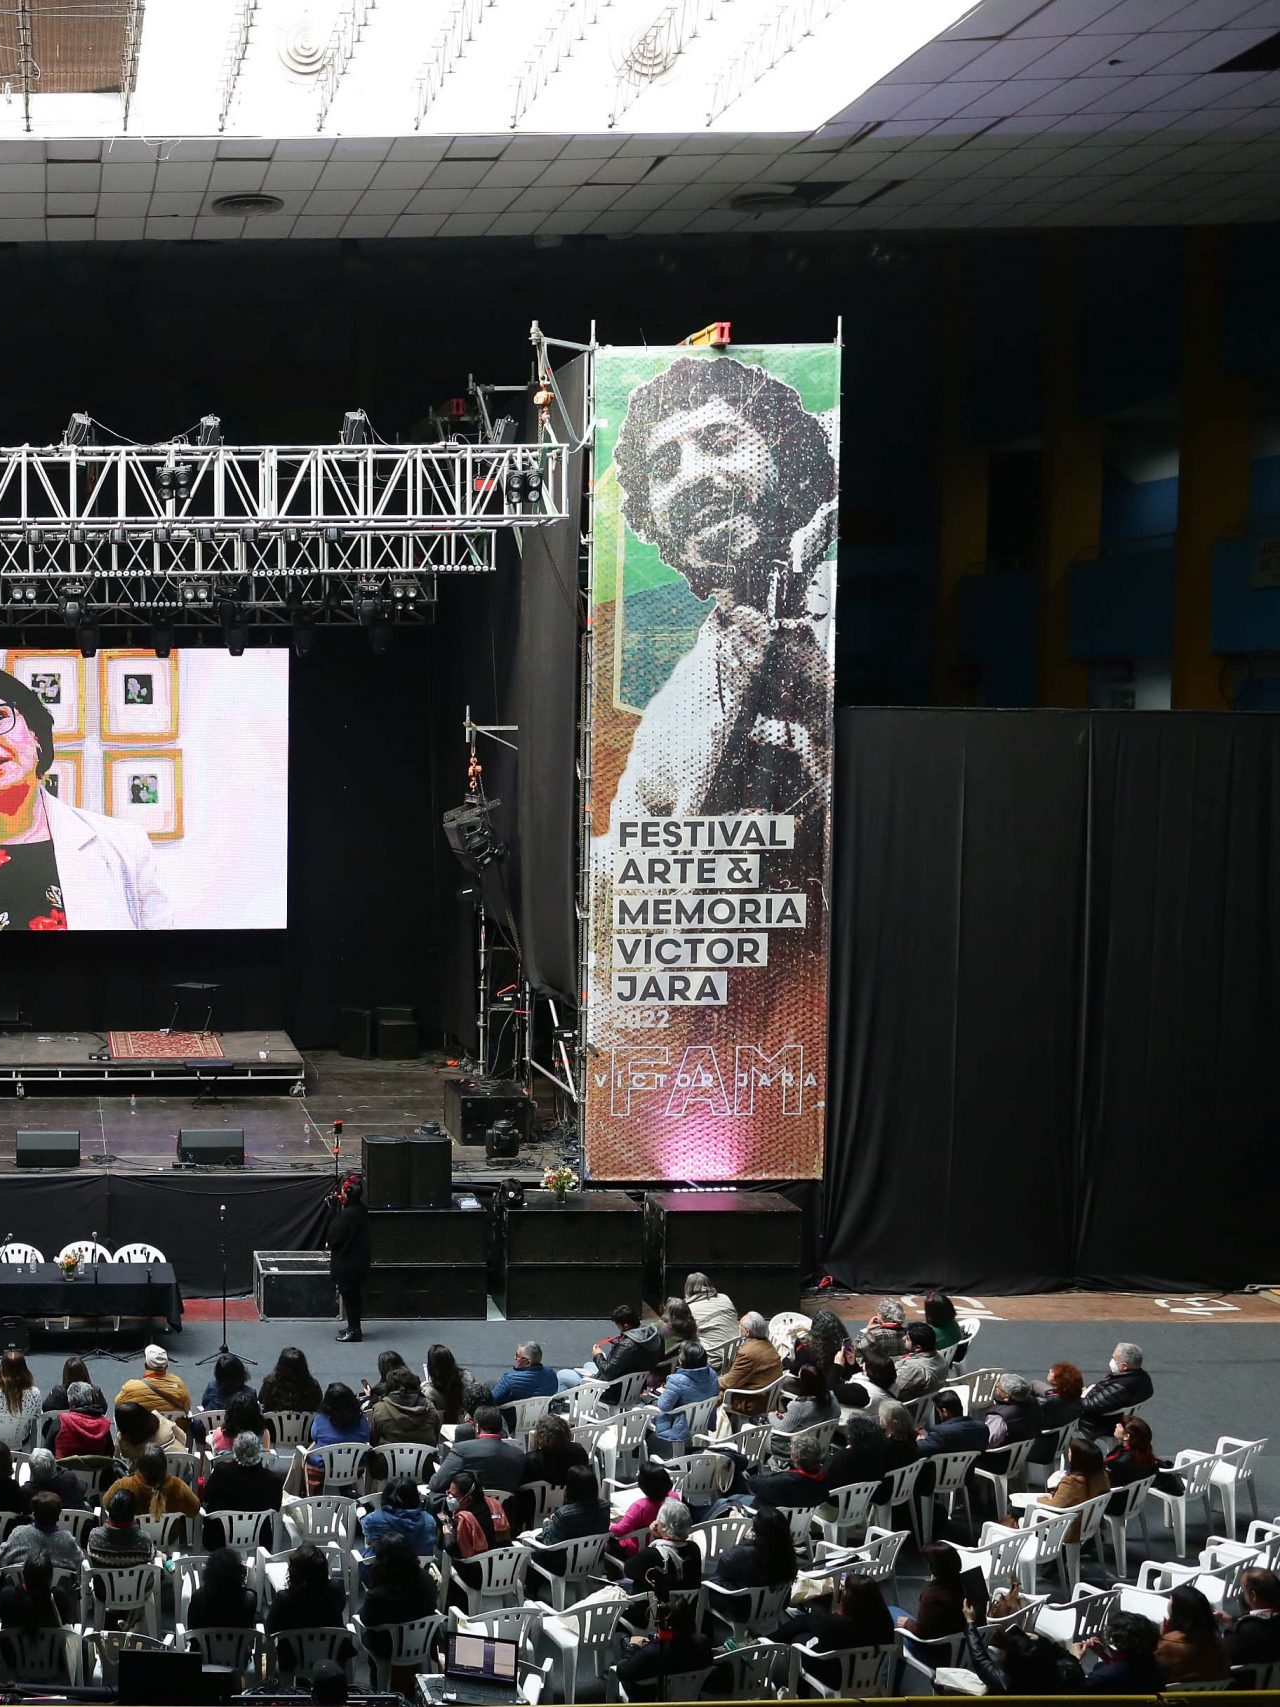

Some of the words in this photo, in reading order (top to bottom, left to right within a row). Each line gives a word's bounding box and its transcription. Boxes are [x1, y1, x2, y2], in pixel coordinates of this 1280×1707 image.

[620, 820, 787, 848] FESTIVAL
[618, 857, 717, 884] ARTE
[726, 857, 753, 884] &
[617, 897, 802, 925] MEMORIA
[616, 933, 761, 965] VÍCTOR
[616, 974, 721, 1002] JARA
[612, 1009, 670, 1029] 2022
[594, 1070, 714, 1088] VÍCTOR
[736, 1072, 818, 1088] JARA
[610, 1044, 803, 1117] FAM
